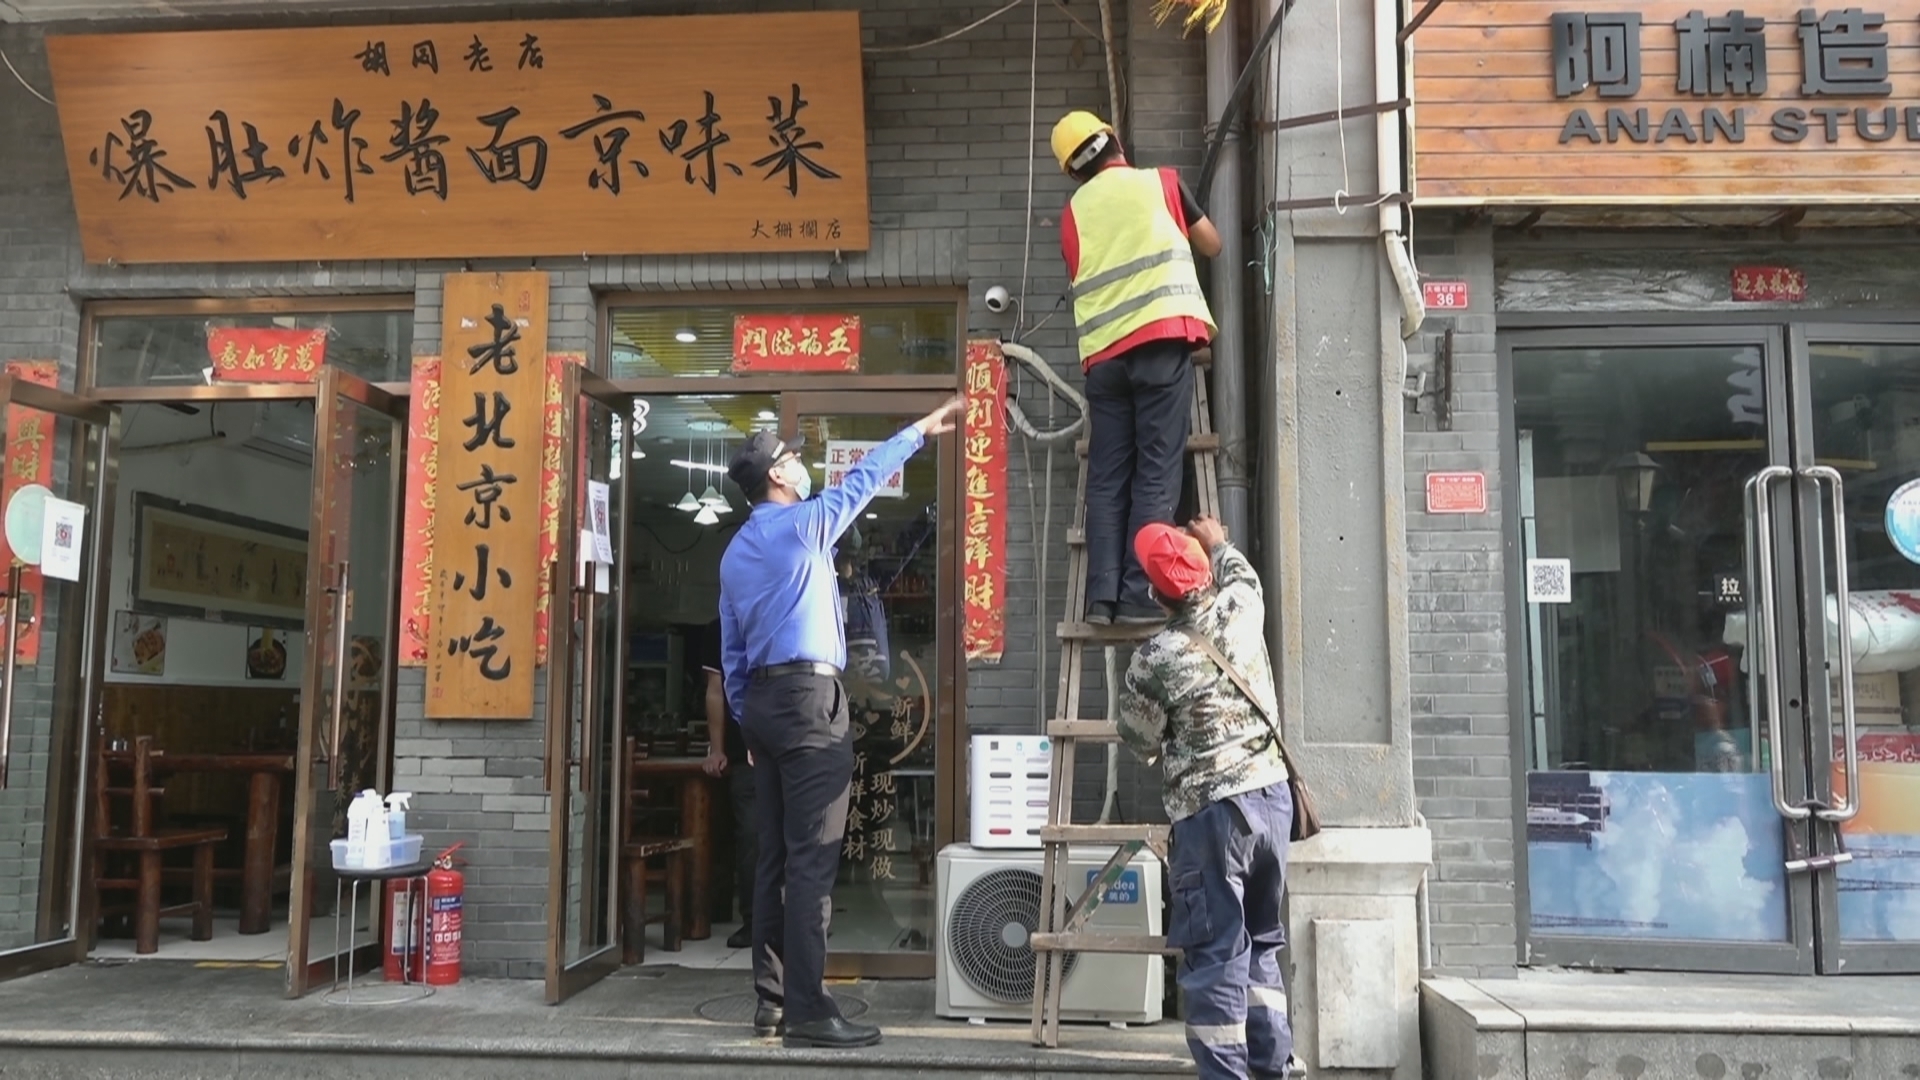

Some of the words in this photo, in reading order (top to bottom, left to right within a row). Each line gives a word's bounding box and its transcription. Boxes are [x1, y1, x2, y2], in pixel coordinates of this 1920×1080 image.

[353, 33, 544, 77] 胡同老店
[1558, 107, 1746, 144] ANAN
[1436, 293, 1454, 306] 36
[830, 447, 875, 465] 正常
[447, 303, 522, 681] 老北京小吃
[1722, 578, 1740, 595] 拉
[870, 771, 896, 880] 现炒现做
